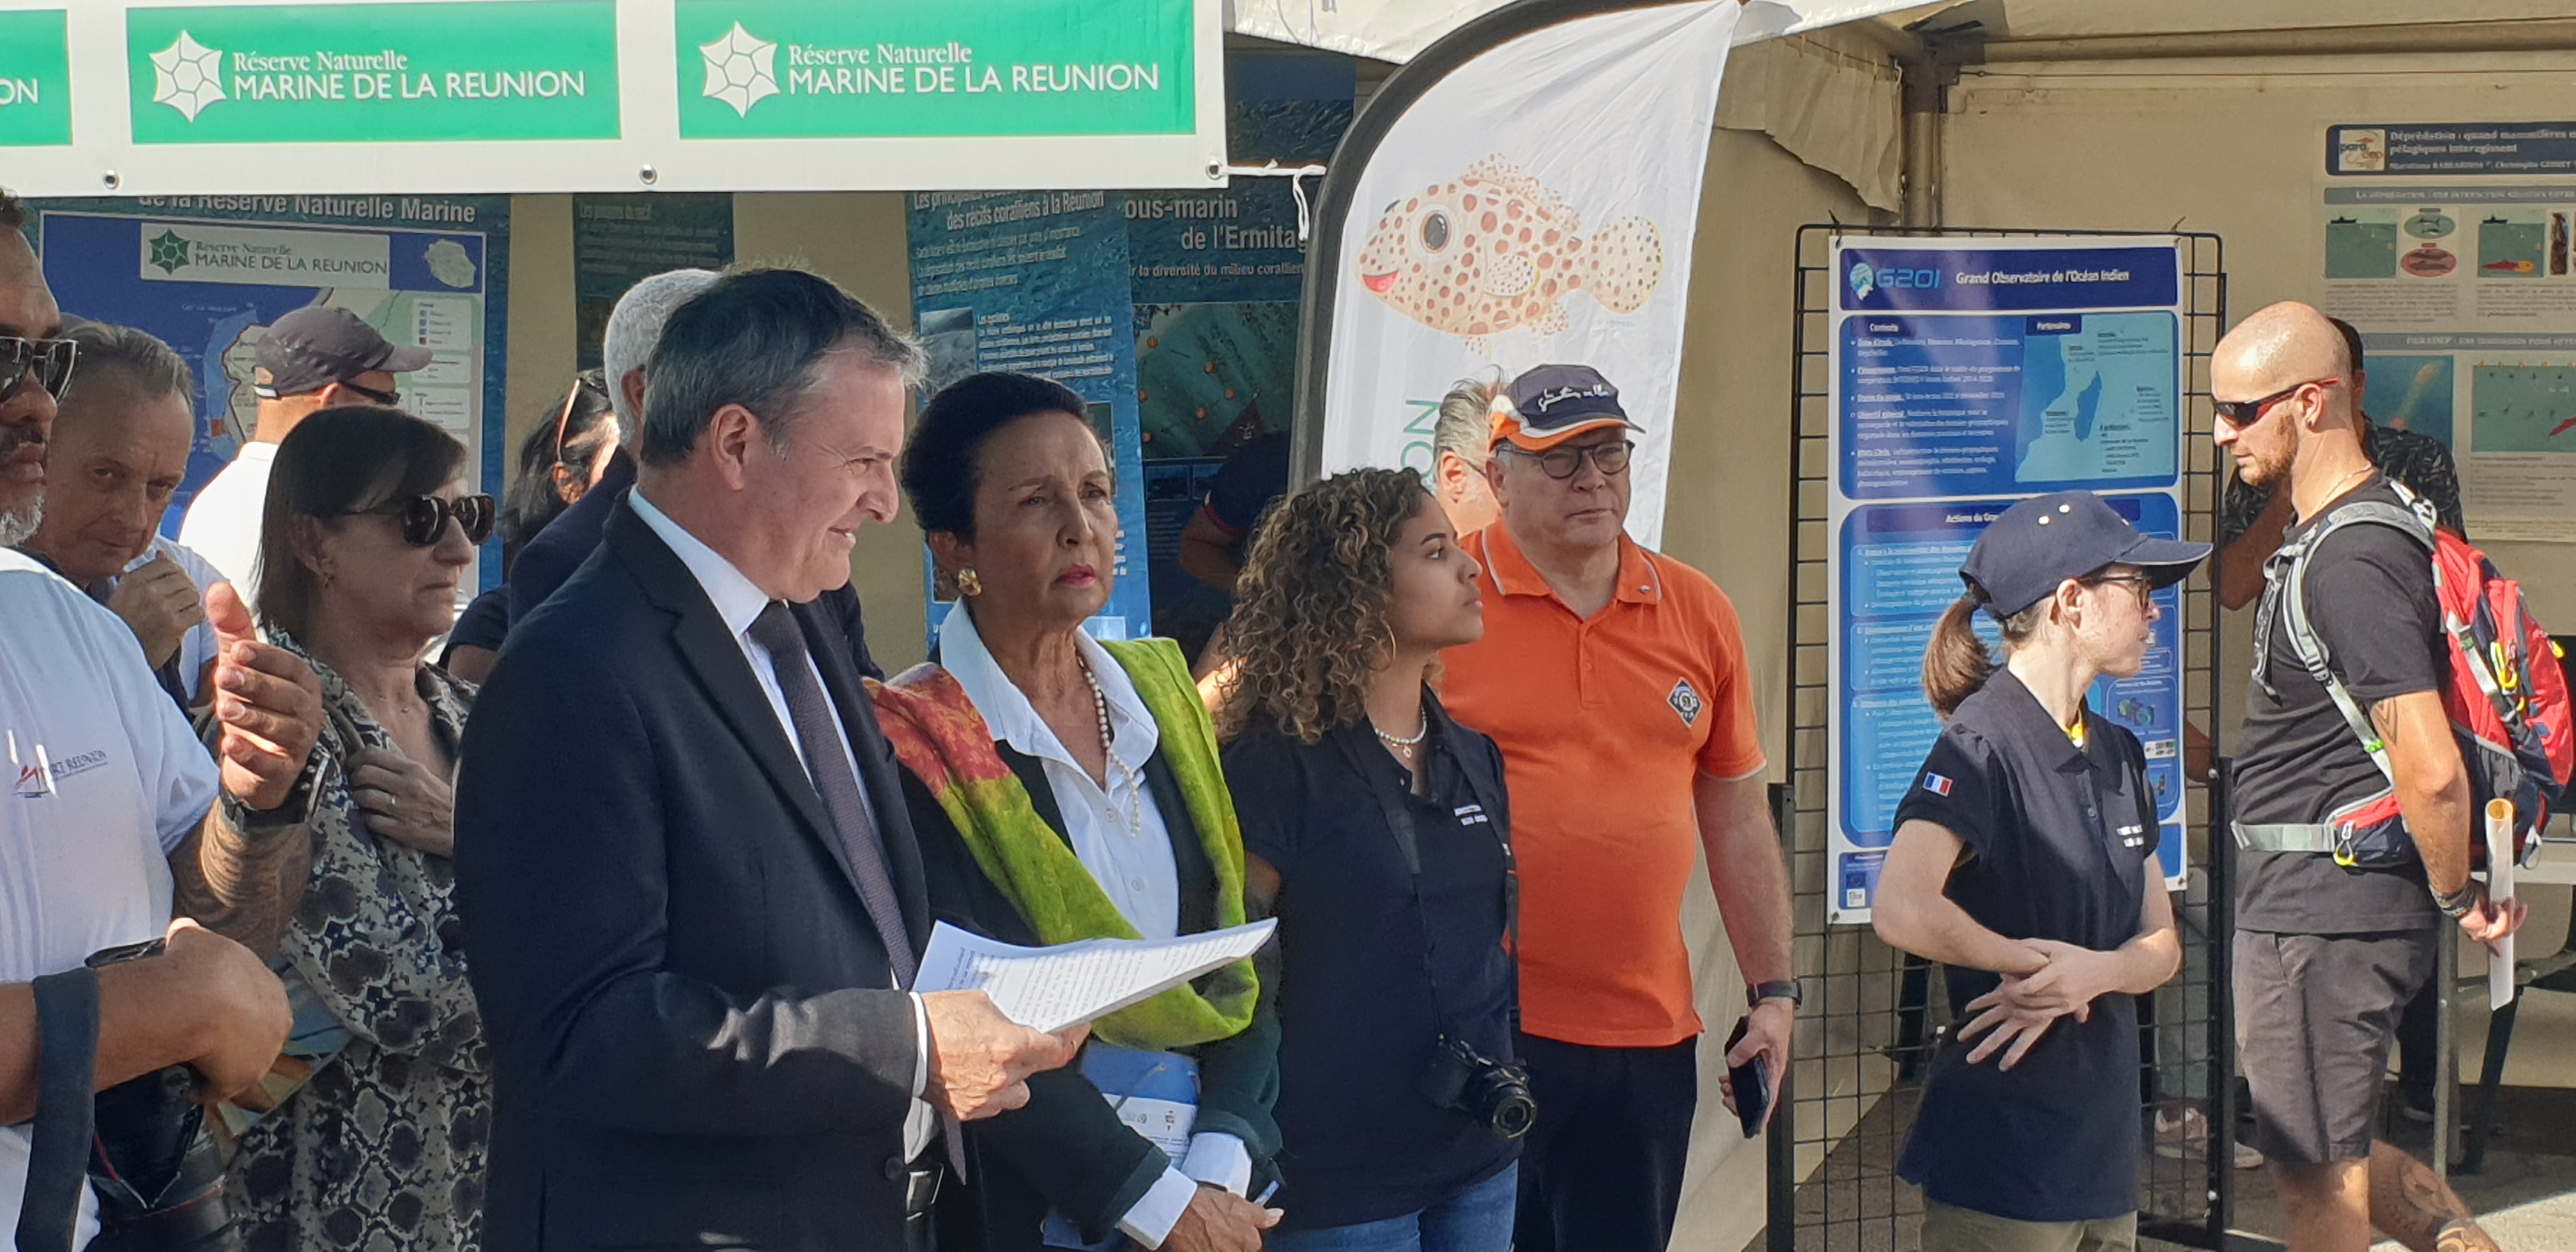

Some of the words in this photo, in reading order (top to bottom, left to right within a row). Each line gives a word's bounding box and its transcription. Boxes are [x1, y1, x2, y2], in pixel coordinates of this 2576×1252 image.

[233, 50, 310, 72] Réserve
[316, 49, 408, 71] Naturelle
[788, 43, 870, 65] Réserve
[877, 42, 972, 64] Naturelle
[234, 73, 345, 100] MARINE
[353, 73, 392, 100] DE
[401, 72, 438, 99] LA
[446, 70, 585, 98] REUNION
[789, 67, 906, 95] MARINE
[915, 66, 955, 93] DE
[965, 65, 1003, 93] LA
[1012, 63, 1158, 92] REUNION
[295, 195, 394, 218] Naturelle
[401, 198, 476, 222] Marine
[947, 211, 965, 231] des
[1051, 194, 1061, 214] la
[1181, 226, 1206, 250] de
[195, 254, 256, 268] MARINE
[261, 256, 282, 270] DE
[288, 257, 307, 271] LA
[312, 258, 387, 274] REUNION
[1956, 271, 1989, 284] Grand
[2051, 270, 2064, 283] de
